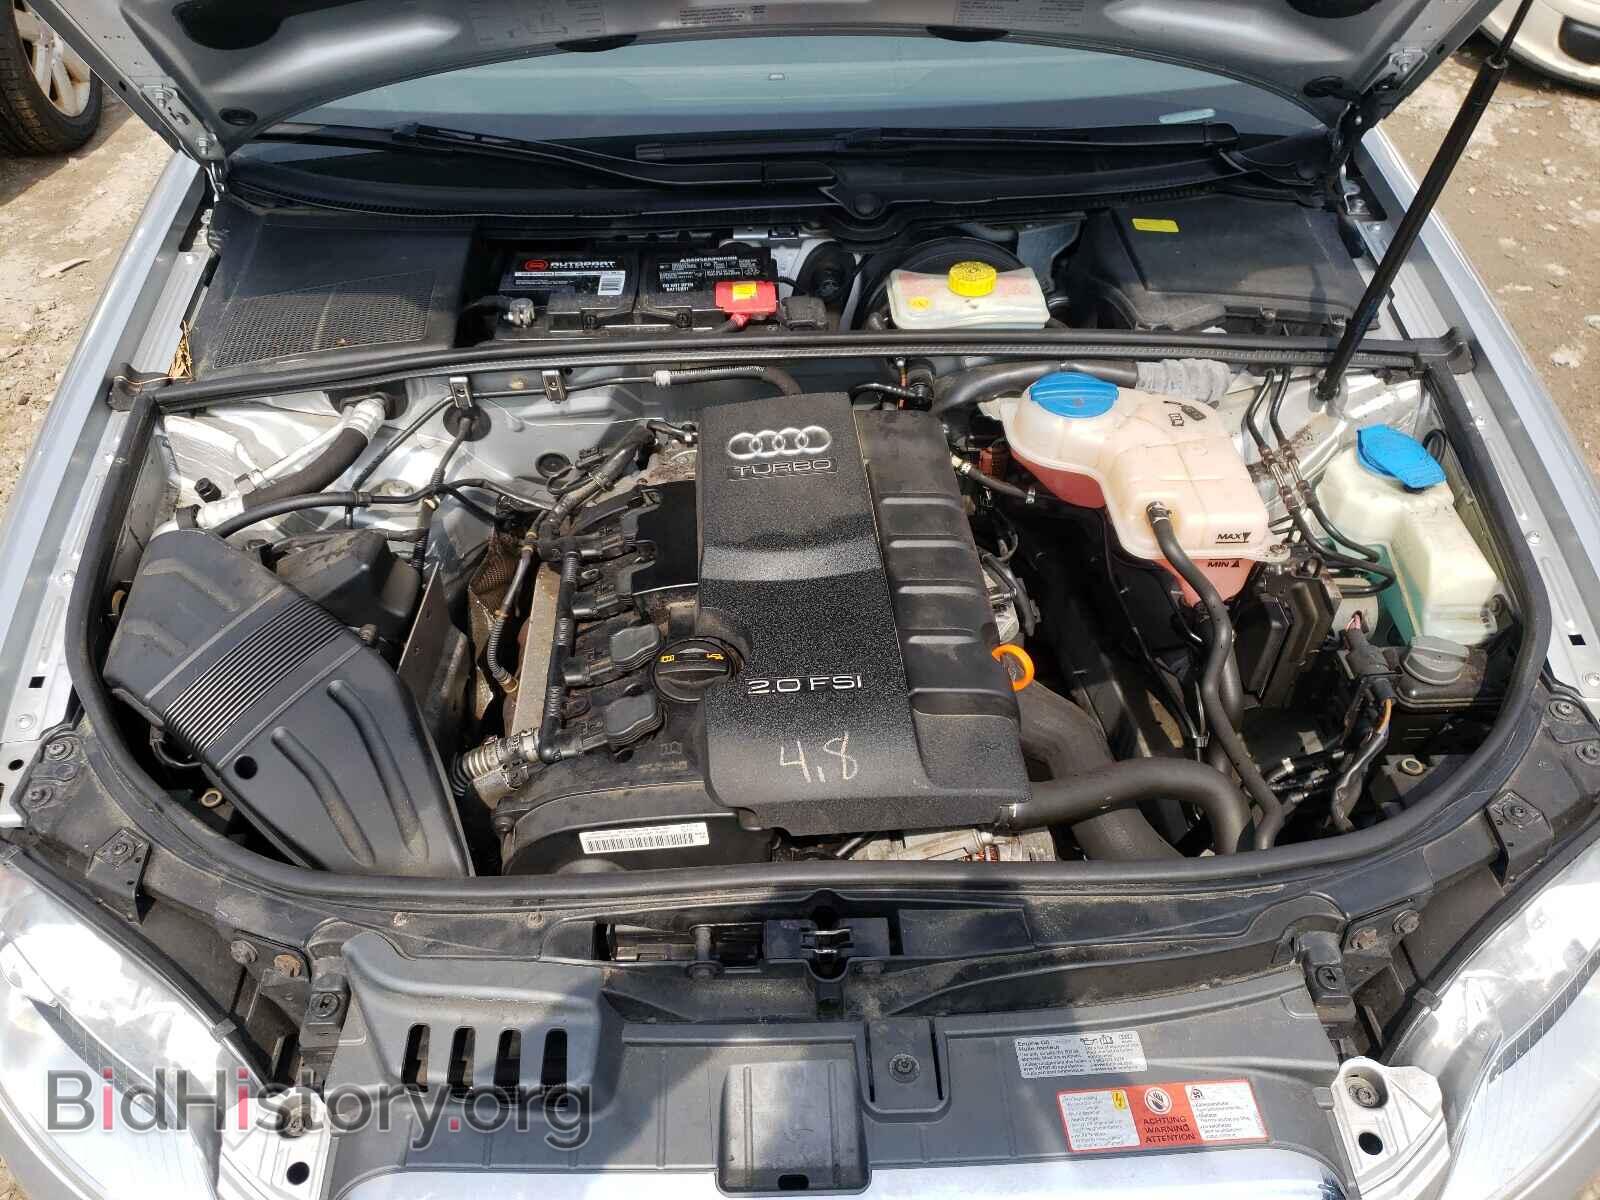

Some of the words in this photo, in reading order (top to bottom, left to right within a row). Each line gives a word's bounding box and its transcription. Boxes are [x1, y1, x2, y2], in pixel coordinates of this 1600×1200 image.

[733, 459, 831, 477] TURBO
[1207, 560, 1229, 568] MIN
[747, 678, 801, 695] 2.0
[809, 675, 862, 691] FSI
[1143, 1116, 1187, 1126] ACHTUNG
[1144, 1123, 1190, 1134] WARNING
[1145, 1132, 1196, 1144] ATTENTION
